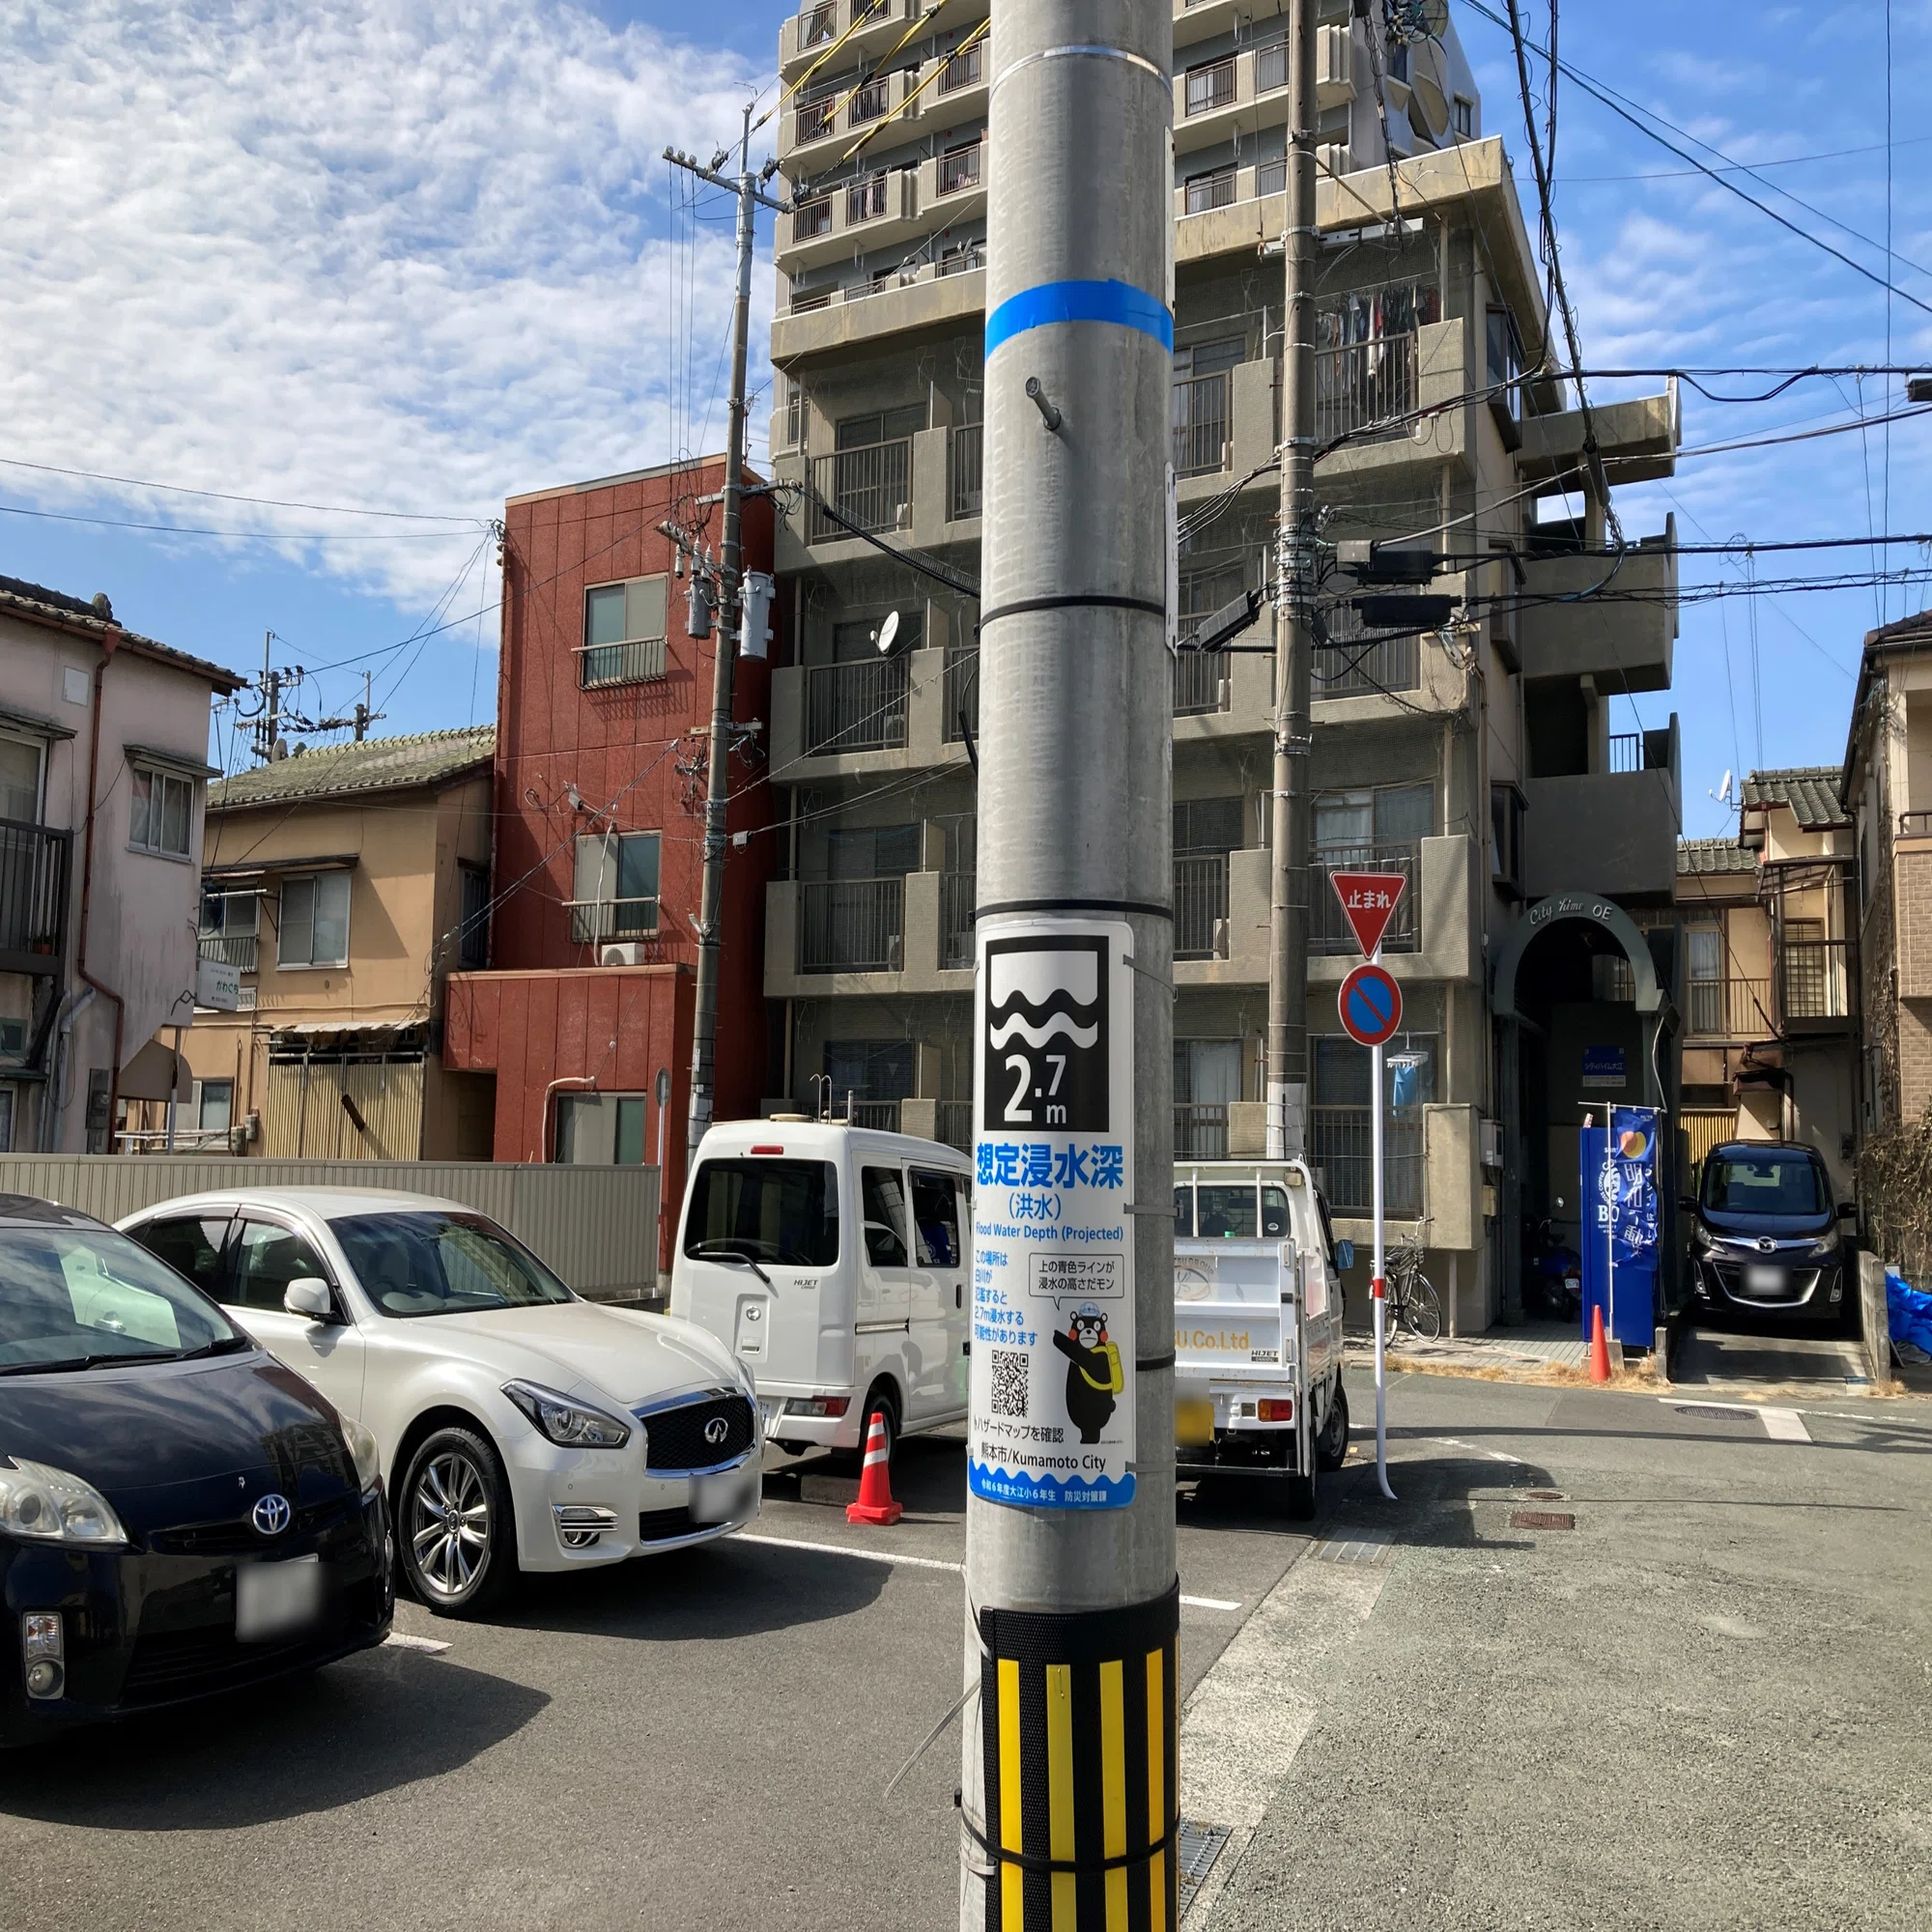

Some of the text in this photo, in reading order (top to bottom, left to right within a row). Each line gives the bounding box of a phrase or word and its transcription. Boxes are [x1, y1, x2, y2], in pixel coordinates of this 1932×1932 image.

[1347, 889, 1391, 909] 止まれ
[1529, 905, 1552, 924] City
[1592, 904, 1612, 921] OE
[1004, 1054, 1066, 1122] 2.7
[977, 1142, 1123, 1189] 想定浸水深
[1009, 1191, 1062, 1220] (洪水)
[1598, 1205, 1620, 1222] BO
[976, 1221, 1123, 1243] Flood Water Depth (Projected)
[976, 1250, 1008, 1266] この場所は
[1038, 1260, 1115, 1274] 上の青色ラインが
[975, 1268, 993, 1284] 白川が
[1038, 1275, 1115, 1291] 浸水の高さだモン
[975, 1306, 1024, 1325] 2.7m浸水する
[975, 1323, 1037, 1347] 可能性があります
[1082, 1454, 1106, 1472] City
